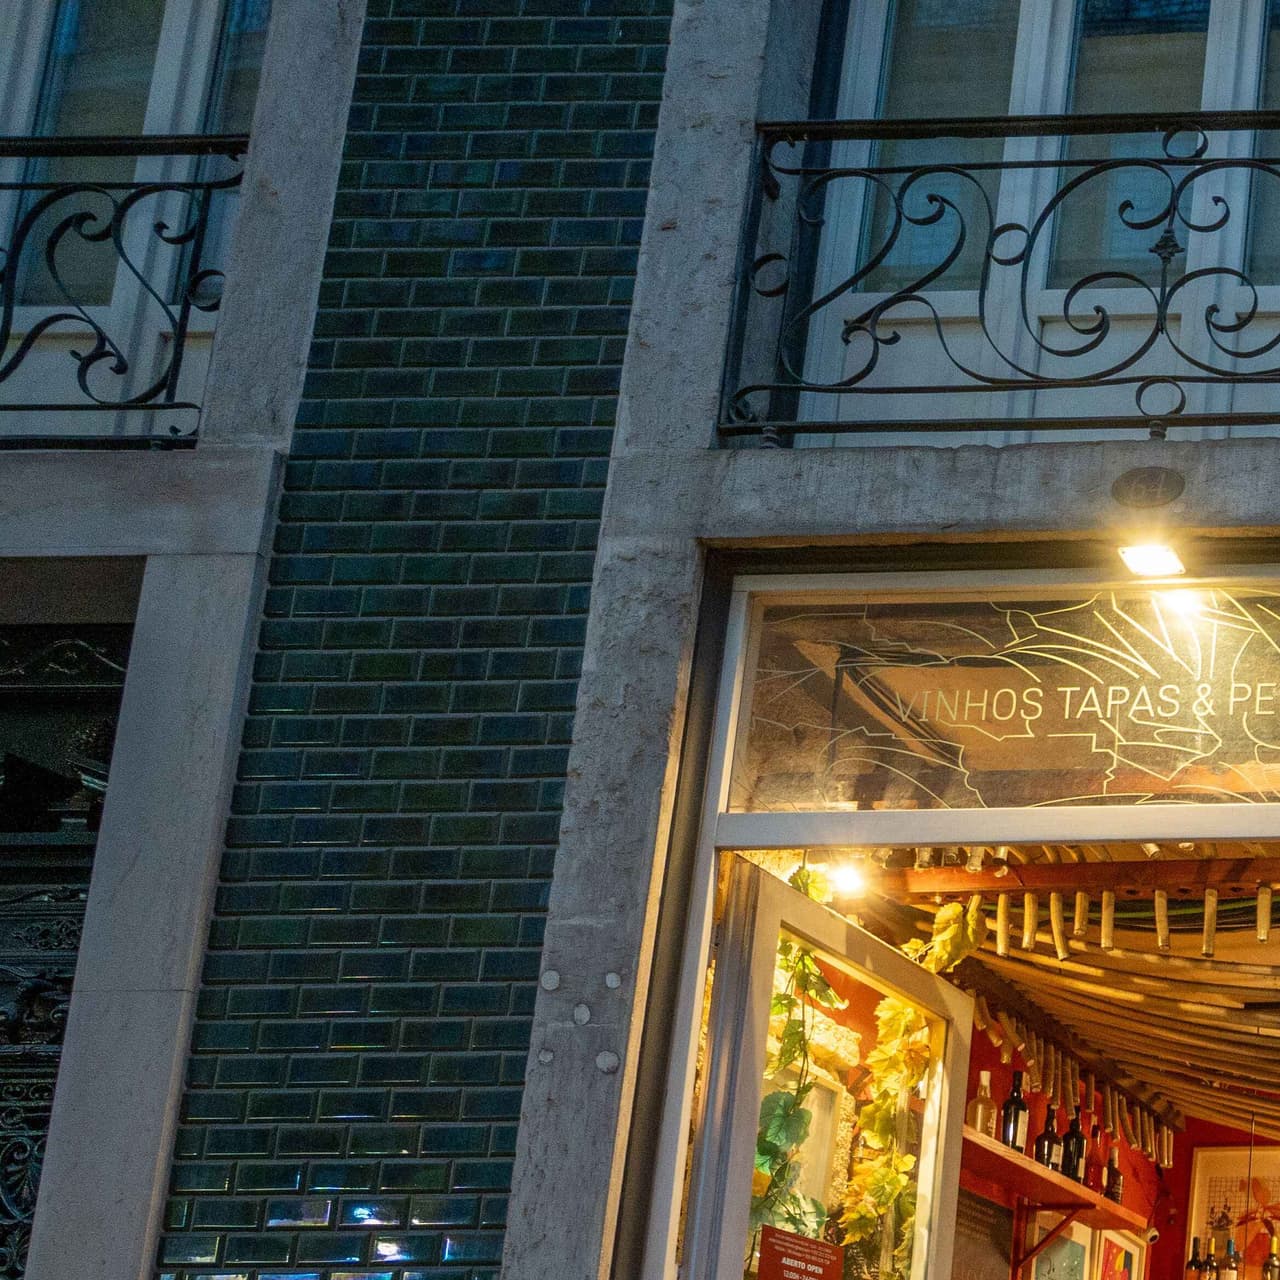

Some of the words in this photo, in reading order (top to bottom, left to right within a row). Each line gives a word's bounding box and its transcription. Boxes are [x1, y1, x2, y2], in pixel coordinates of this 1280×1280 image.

[896, 687, 1044, 722] VINHOS
[1056, 684, 1183, 719] TAPAS
[1191, 683, 1216, 718] &
